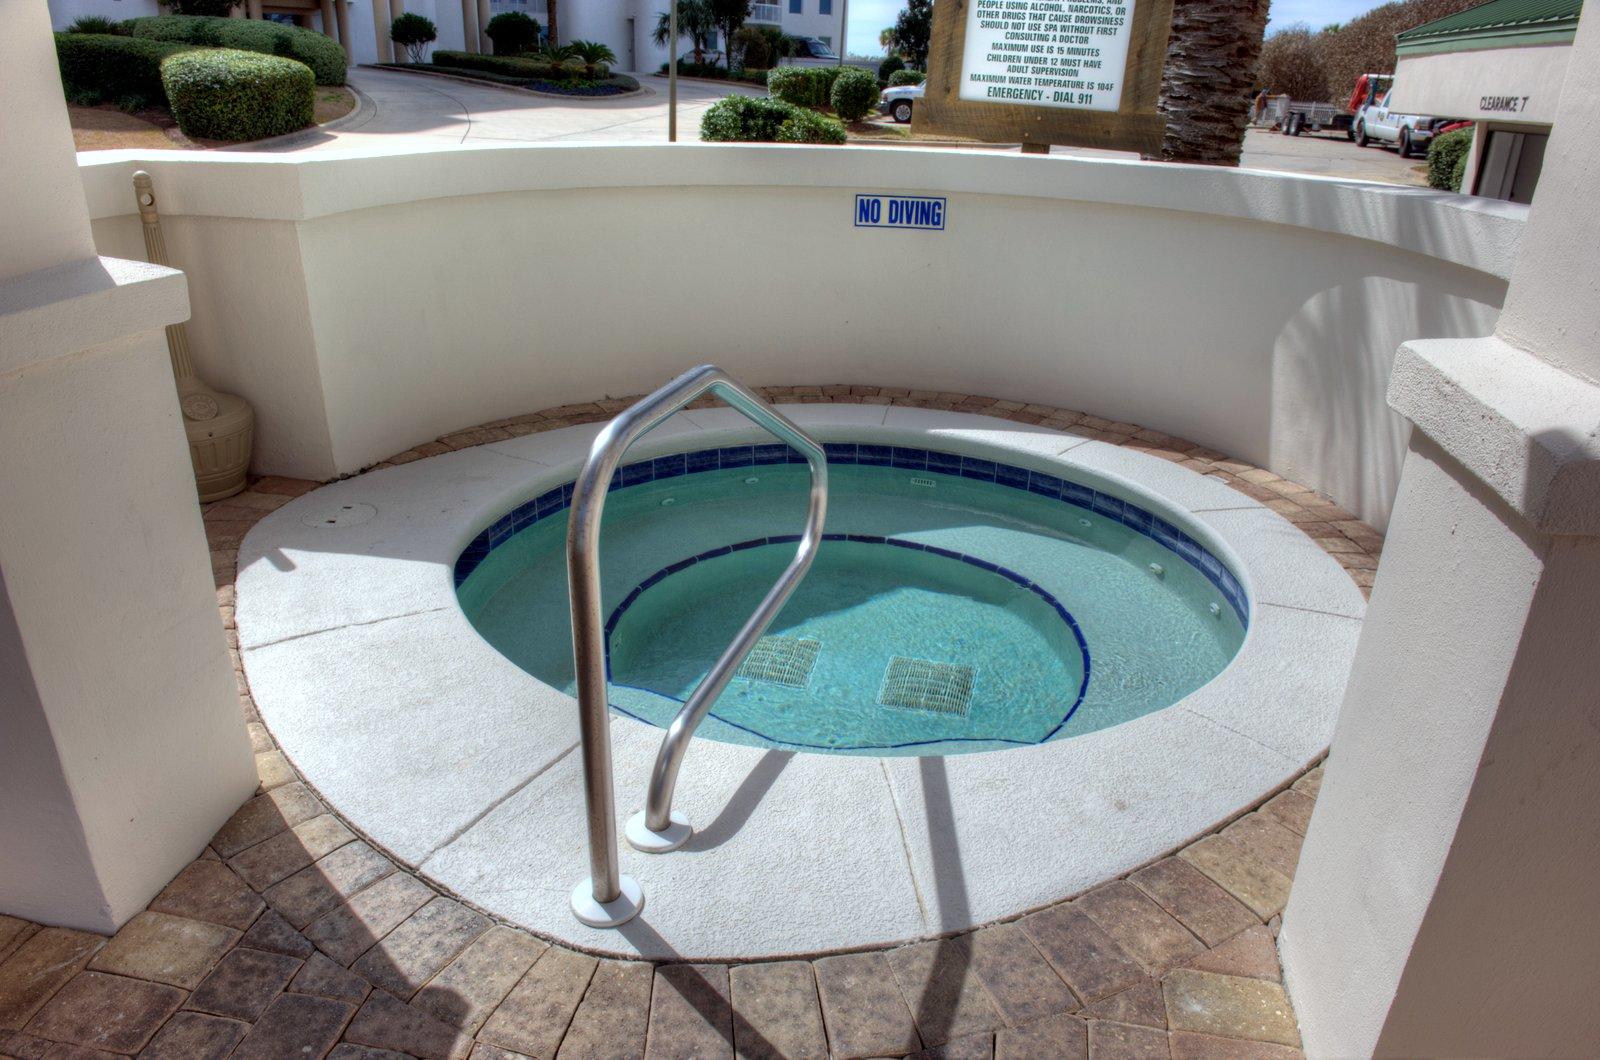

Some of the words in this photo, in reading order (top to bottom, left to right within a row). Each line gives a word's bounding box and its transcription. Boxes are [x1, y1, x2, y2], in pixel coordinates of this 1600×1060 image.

[1115, 7, 1126, 15] OR
[1049, 14, 1072, 23] CAUSE
[1075, 15, 1124, 25] DROWSINESS
[980, 21, 1008, 29] SHOULD
[1060, 24, 1094, 34] WITHOUT
[1097, 27, 1117, 35] FIRST
[1005, 32, 1049, 42] CONSULTING
[1059, 35, 1089, 44] DOCTOR
[992, 43, 1028, 52] MAXIMUM
[1067, 47, 1100, 57] MINUTES
[987, 54, 1021, 63] CHILDREN
[1024, 56, 1047, 65] UNDER
[1060, 59, 1080, 67] MUST
[1084, 60, 1102, 68] HAVE
[1007, 65, 1028, 73] ADULT
[1031, 66, 1079, 77] SUPERVISION
[970, 74, 1006, 83] MAXIMUM
[1008, 76, 1032, 85] WATER
[1034, 78, 1084, 89] TEMPERATURE
[1087, 82, 1094, 90] IS
[988, 86, 1043, 100] EMERGENCY
[1053, 91, 1075, 103] DIAL
[1078, 92, 1092, 104] 911
[1480, 96, 1519, 112] CLEARANCE
[858, 198, 881, 224] NO
[888, 200, 942, 226] DIVING
